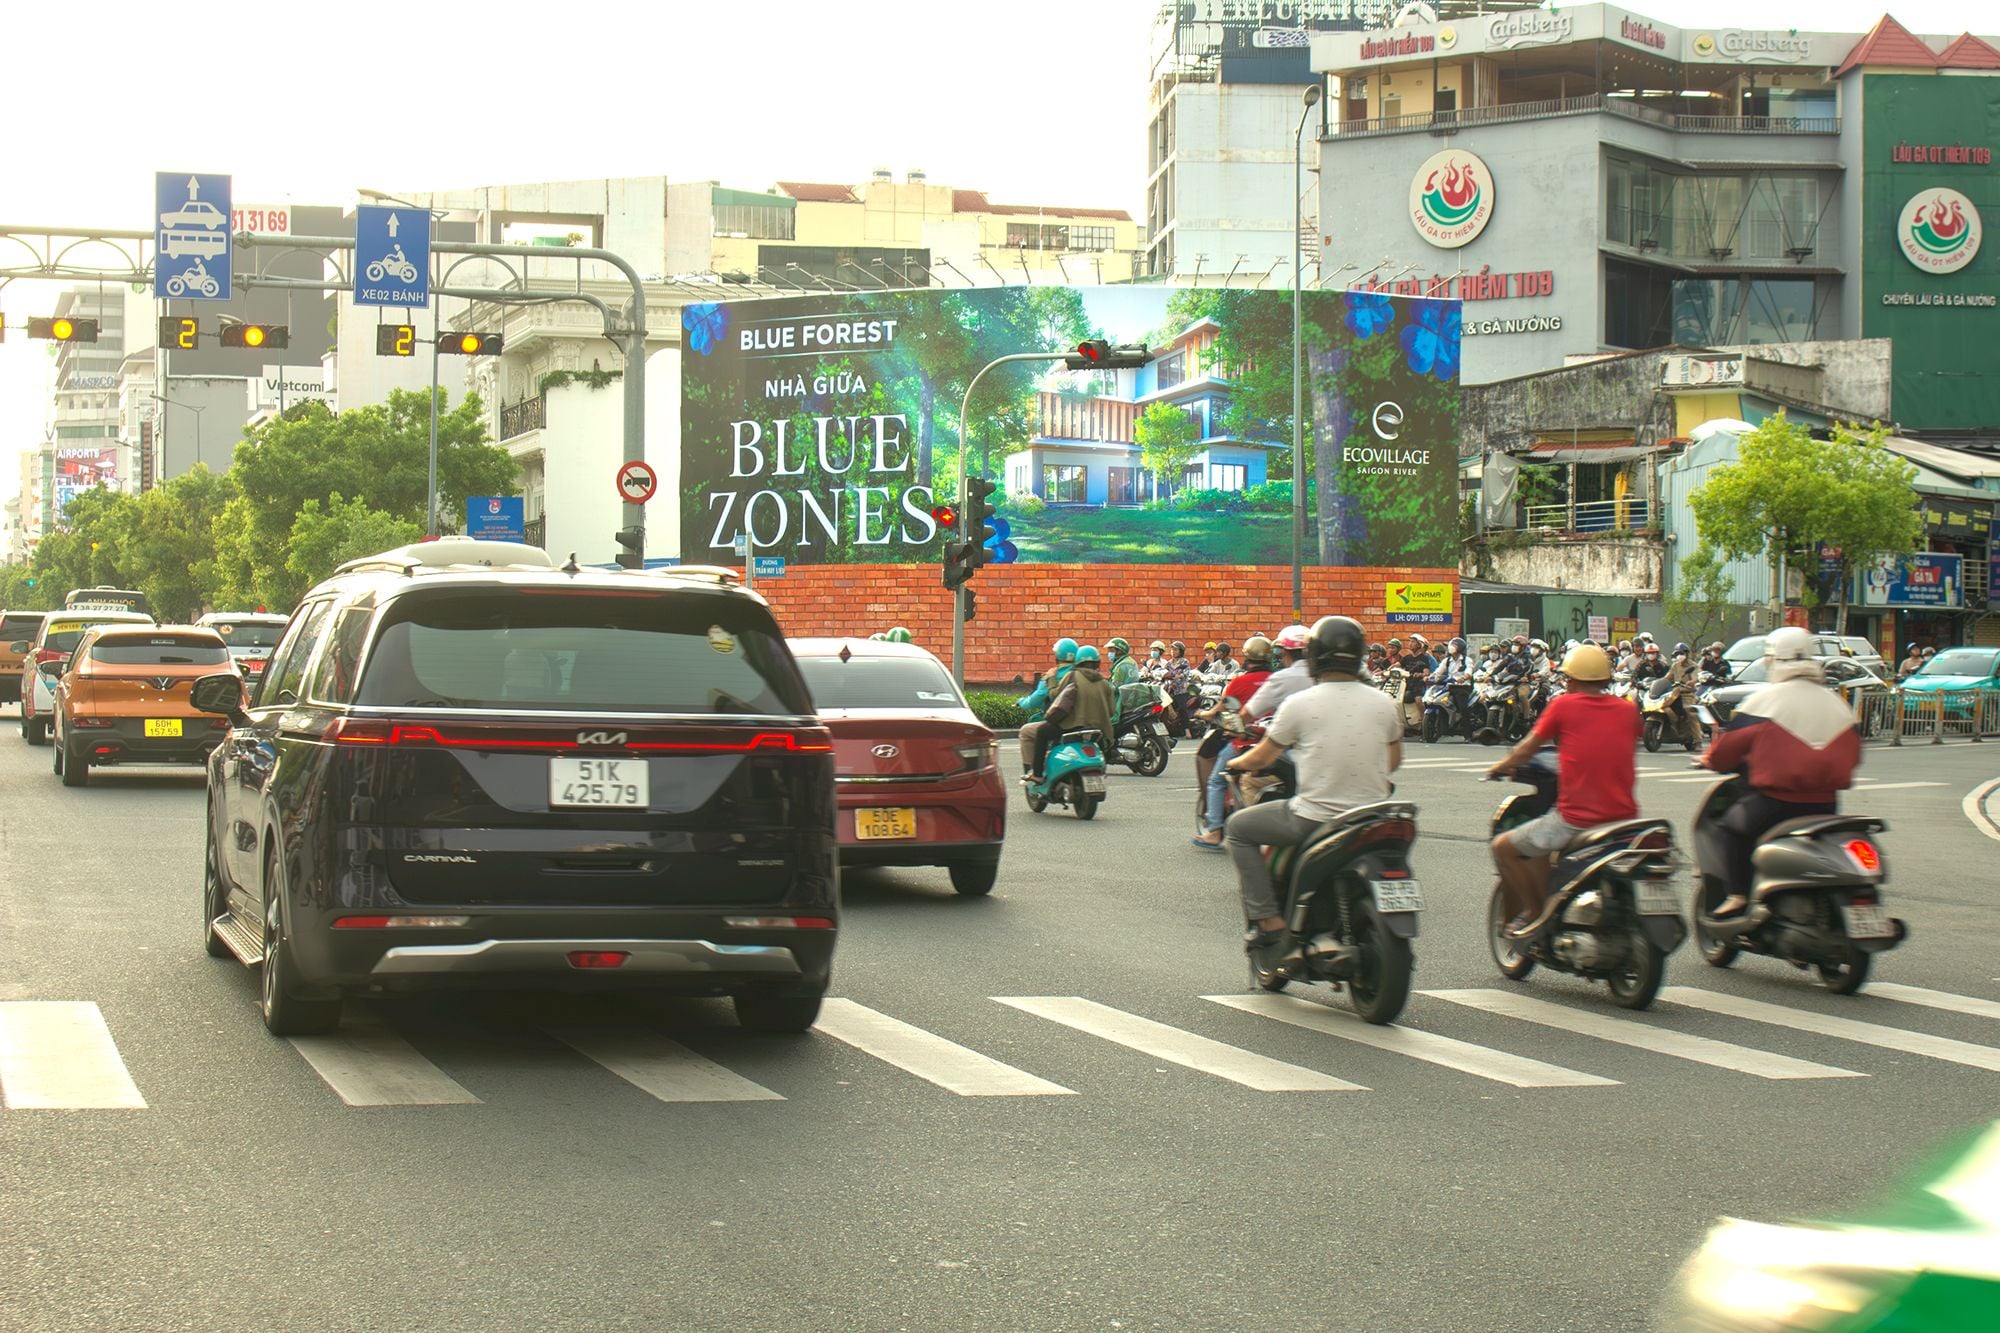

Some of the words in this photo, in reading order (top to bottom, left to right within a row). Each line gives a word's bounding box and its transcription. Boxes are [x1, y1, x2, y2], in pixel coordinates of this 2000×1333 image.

[1489, 13, 1573, 38] Carlsberg
[1716, 28, 1810, 58] Carlsberg
[1972, 147, 1991, 164] 109
[1513, 270, 1553, 297] 109
[392, 289, 424, 302] BÁNH
[179, 319, 196, 348] 2
[1467, 321, 1477, 335] &
[1481, 318, 1502, 334] GÀ
[1505, 314, 1562, 332] NƯỚNG
[396, 327, 412, 355] 2
[740, 327, 795, 351] BLUE
[802, 320, 898, 346] FOREST
[765, 374, 807, 398] NHÀ
[813, 370, 866, 395] GIỮA
[57, 448, 100, 459] AIRPORTS
[729, 413, 910, 478] BLUE
[1343, 447, 1430, 465] ECOVILLAGE
[1357, 467, 1390, 475] SAIGON
[1393, 467, 1417, 476] RIVER
[708, 485, 938, 549] ZONES
[1421, 614, 1429, 622] 39
[1430, 614, 1444, 622] 5555
[150, 728, 179, 736] 157.59
[155, 720, 172, 728] 60H
[576, 731, 627, 745] KIA
[578, 760, 620, 782] 51K
[562, 784, 639, 806] 425.79
[872, 810, 898, 823] 50E
[864, 824, 909, 837] 108.64
[403, 854, 478, 863] CARNIVAL
